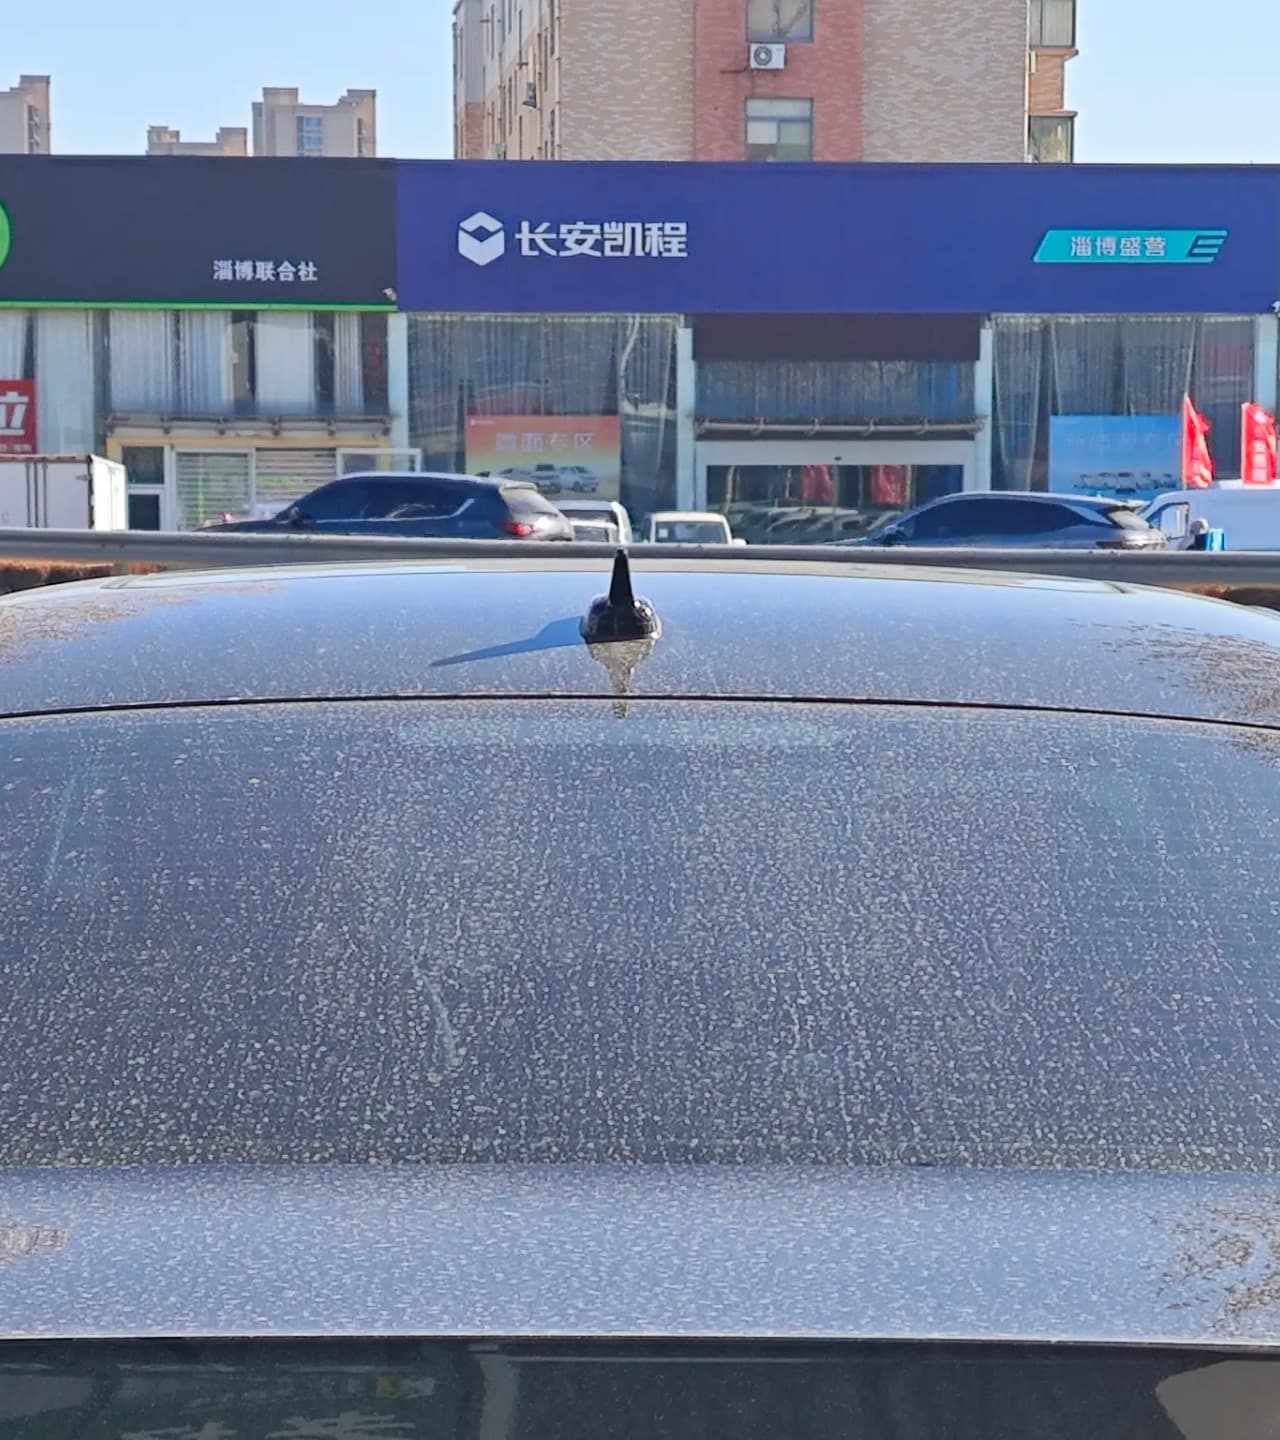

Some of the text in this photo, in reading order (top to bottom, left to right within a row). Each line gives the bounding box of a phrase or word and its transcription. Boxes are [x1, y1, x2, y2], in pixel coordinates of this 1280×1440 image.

[515, 221, 687, 258] 长安凯程
[1070, 235, 1166, 257] 淄博盛营
[213, 260, 318, 282] 淄博联合社
